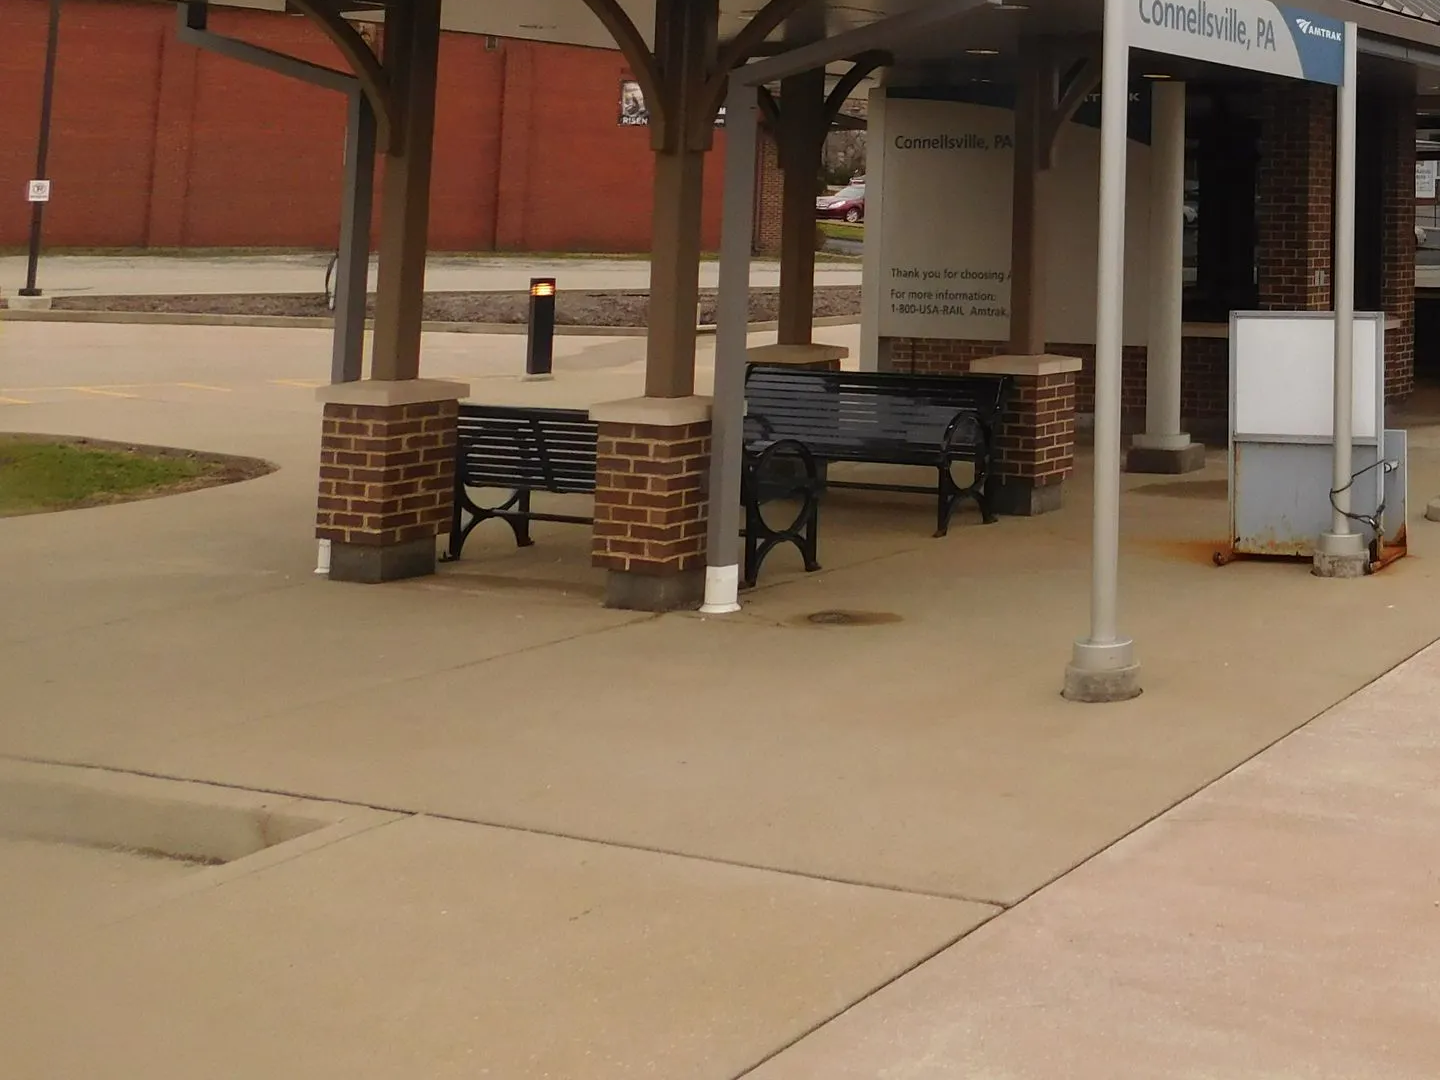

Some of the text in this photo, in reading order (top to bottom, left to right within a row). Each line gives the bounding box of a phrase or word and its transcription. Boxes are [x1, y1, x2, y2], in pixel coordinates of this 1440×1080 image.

[1256, 16, 1277, 52] PA
[1308, 25, 1342, 41] AMTRAK
[622, 116, 648, 125] RISEN
[894, 134, 1013, 151] Connellsville, PA
[891, 268, 920, 279] Thank
[922, 270, 941, 281] you
[943, 268, 958, 279] for
[960, 269, 1005, 283] choosing
[890, 289, 906, 300] For
[908, 291, 933, 300] more
[891, 303, 965, 316] 1-800-USA-RAIL
